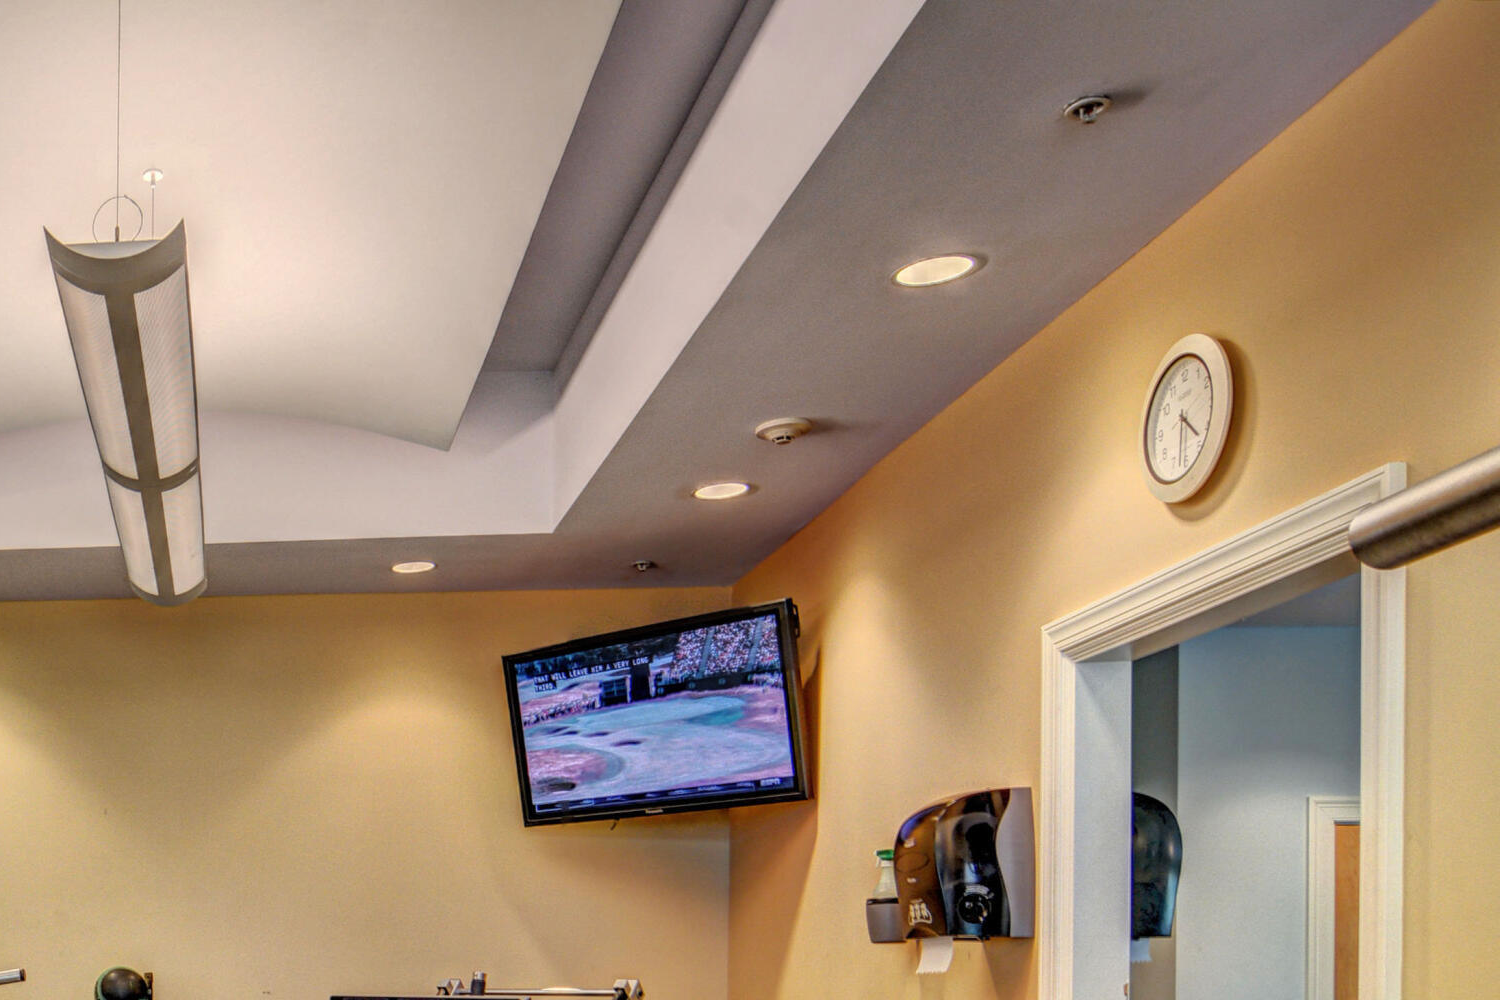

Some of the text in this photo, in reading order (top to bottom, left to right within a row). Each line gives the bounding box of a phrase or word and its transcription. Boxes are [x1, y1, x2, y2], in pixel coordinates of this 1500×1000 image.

[534, 675, 549, 683] THAT
[551, 672, 566, 681] WILL
[569, 667, 588, 677] LEAVE
[613, 660, 630, 669] VERY
[632, 656, 649, 666] LONG
